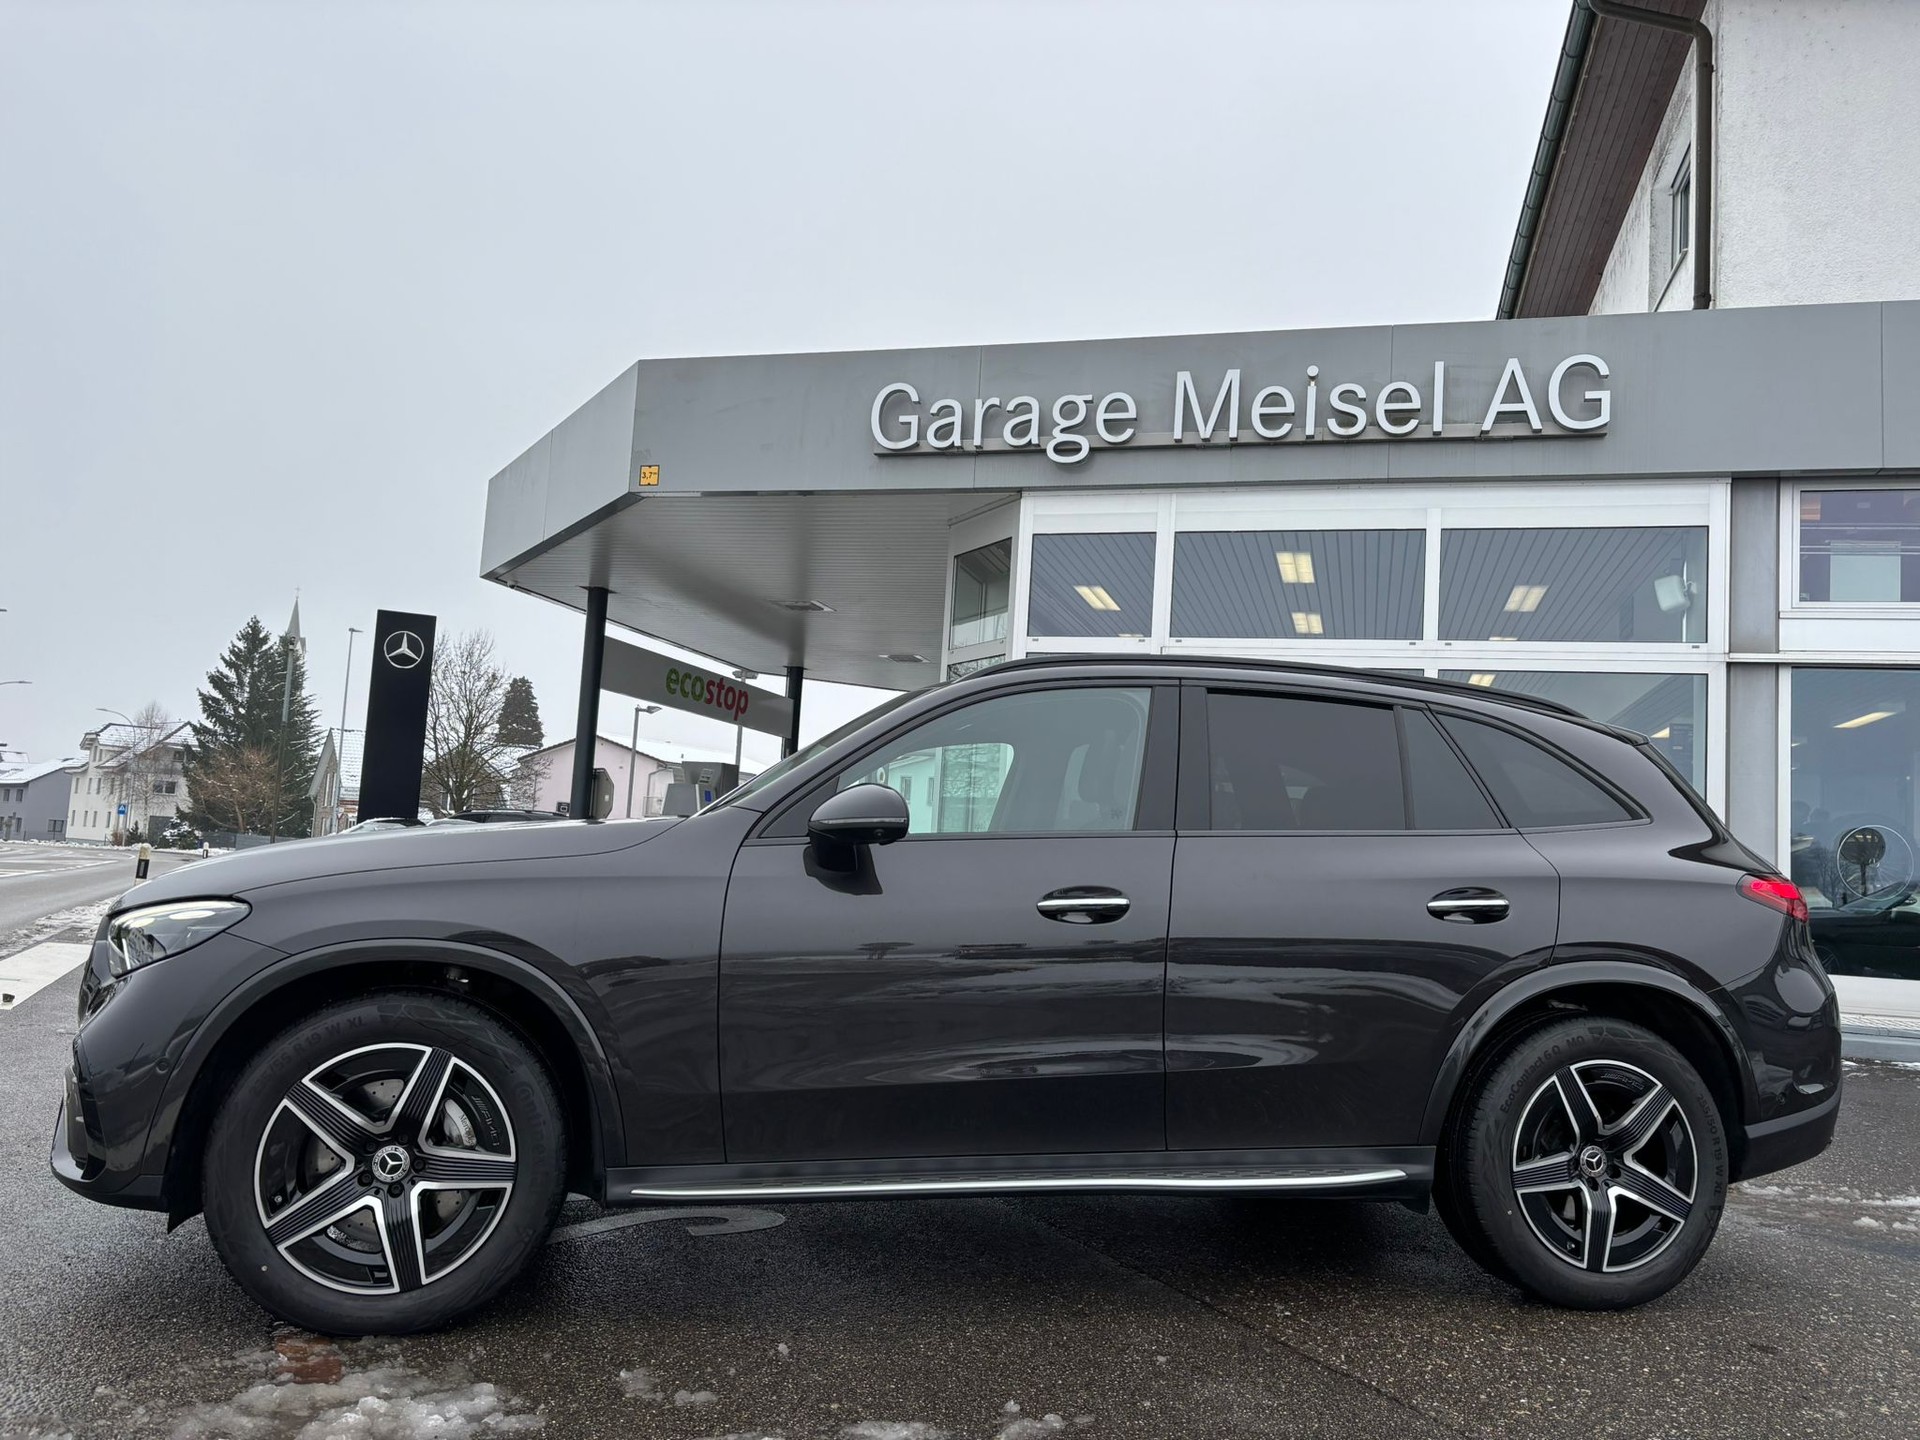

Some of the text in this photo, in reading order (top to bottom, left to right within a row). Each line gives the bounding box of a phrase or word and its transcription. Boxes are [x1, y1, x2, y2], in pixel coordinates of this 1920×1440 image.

[870, 354, 1612, 465] Garage Meisel AG
[665, 667, 749, 721] ecostop
[346, 1015, 367, 1029] XL
[1499, 1057, 1544, 1114] EcoContact
[1714, 1163, 1724, 1177] W
